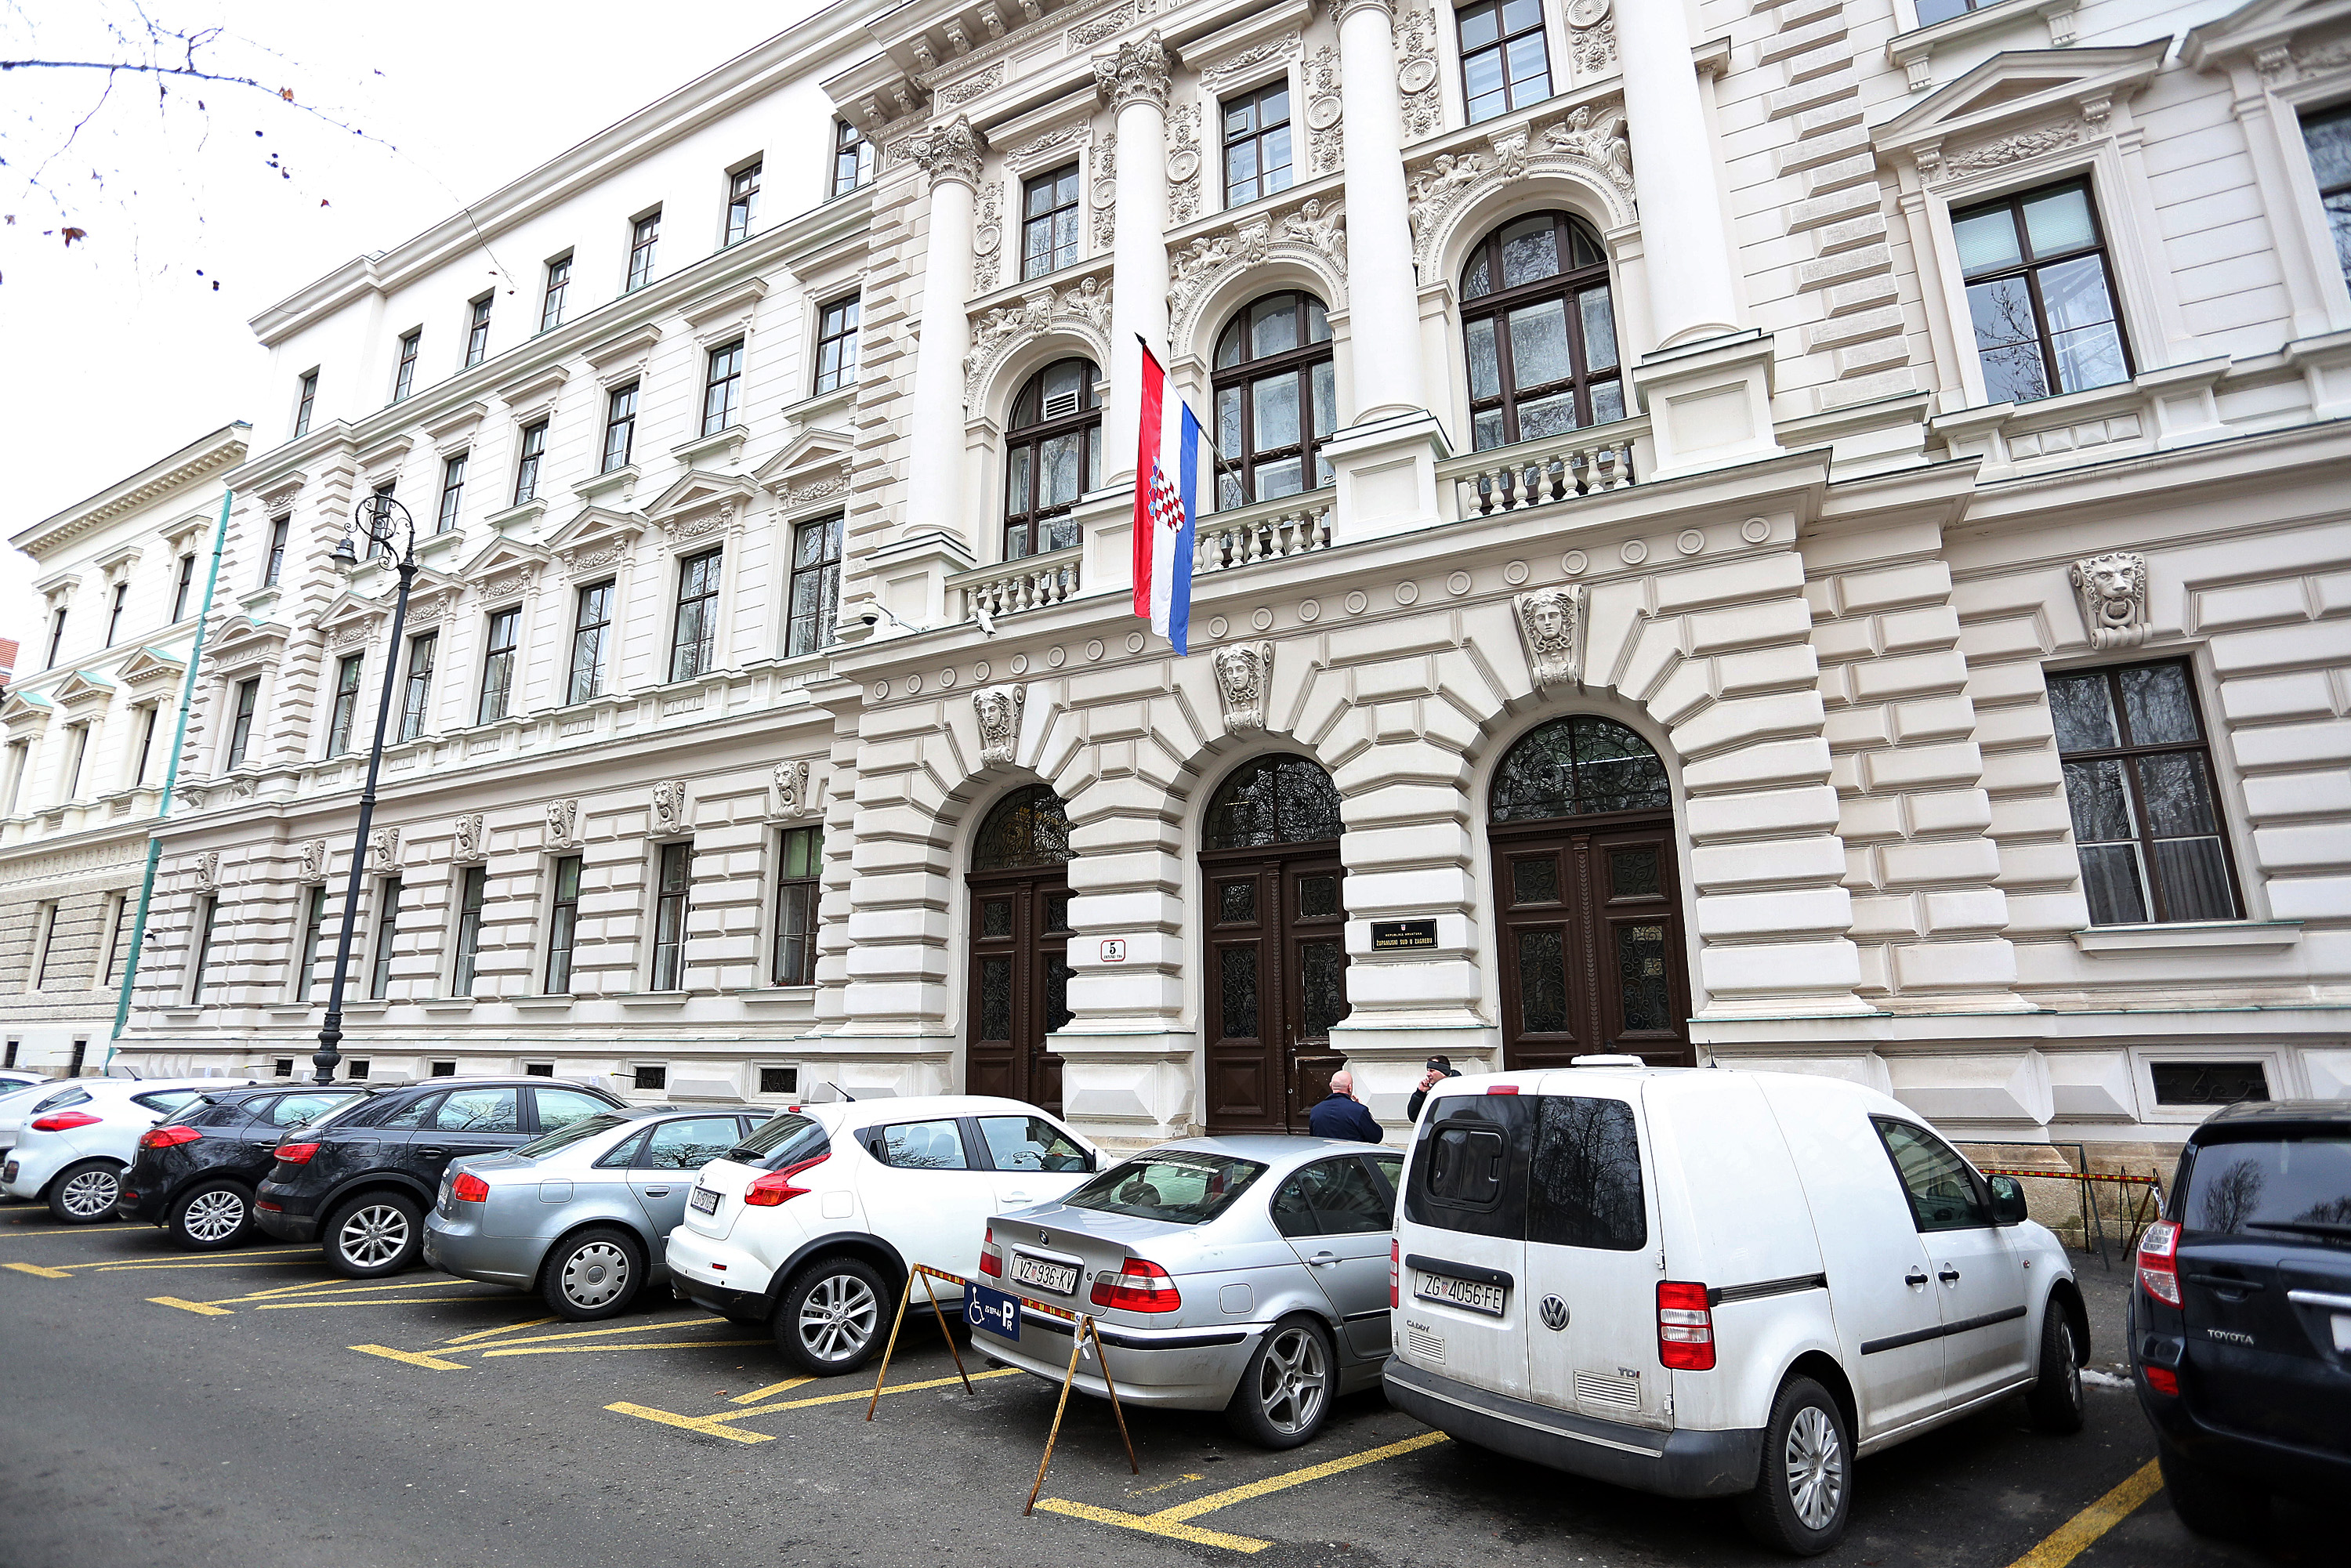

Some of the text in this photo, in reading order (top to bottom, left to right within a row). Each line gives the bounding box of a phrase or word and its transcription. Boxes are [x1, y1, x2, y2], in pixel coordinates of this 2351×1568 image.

[1109, 942, 1117, 954] 5
[1020, 1260, 1074, 1289] VZ 936-KV
[1425, 1275, 1502, 1309] ZG 4056-FE
[1002, 1300, 1015, 1327] P
[1006, 1320, 1012, 1331] R
[1406, 1320, 1430, 1332] CADDY
[2207, 1329, 2255, 1345] TOYOTA
[1617, 1366, 1641, 1379] TDI
